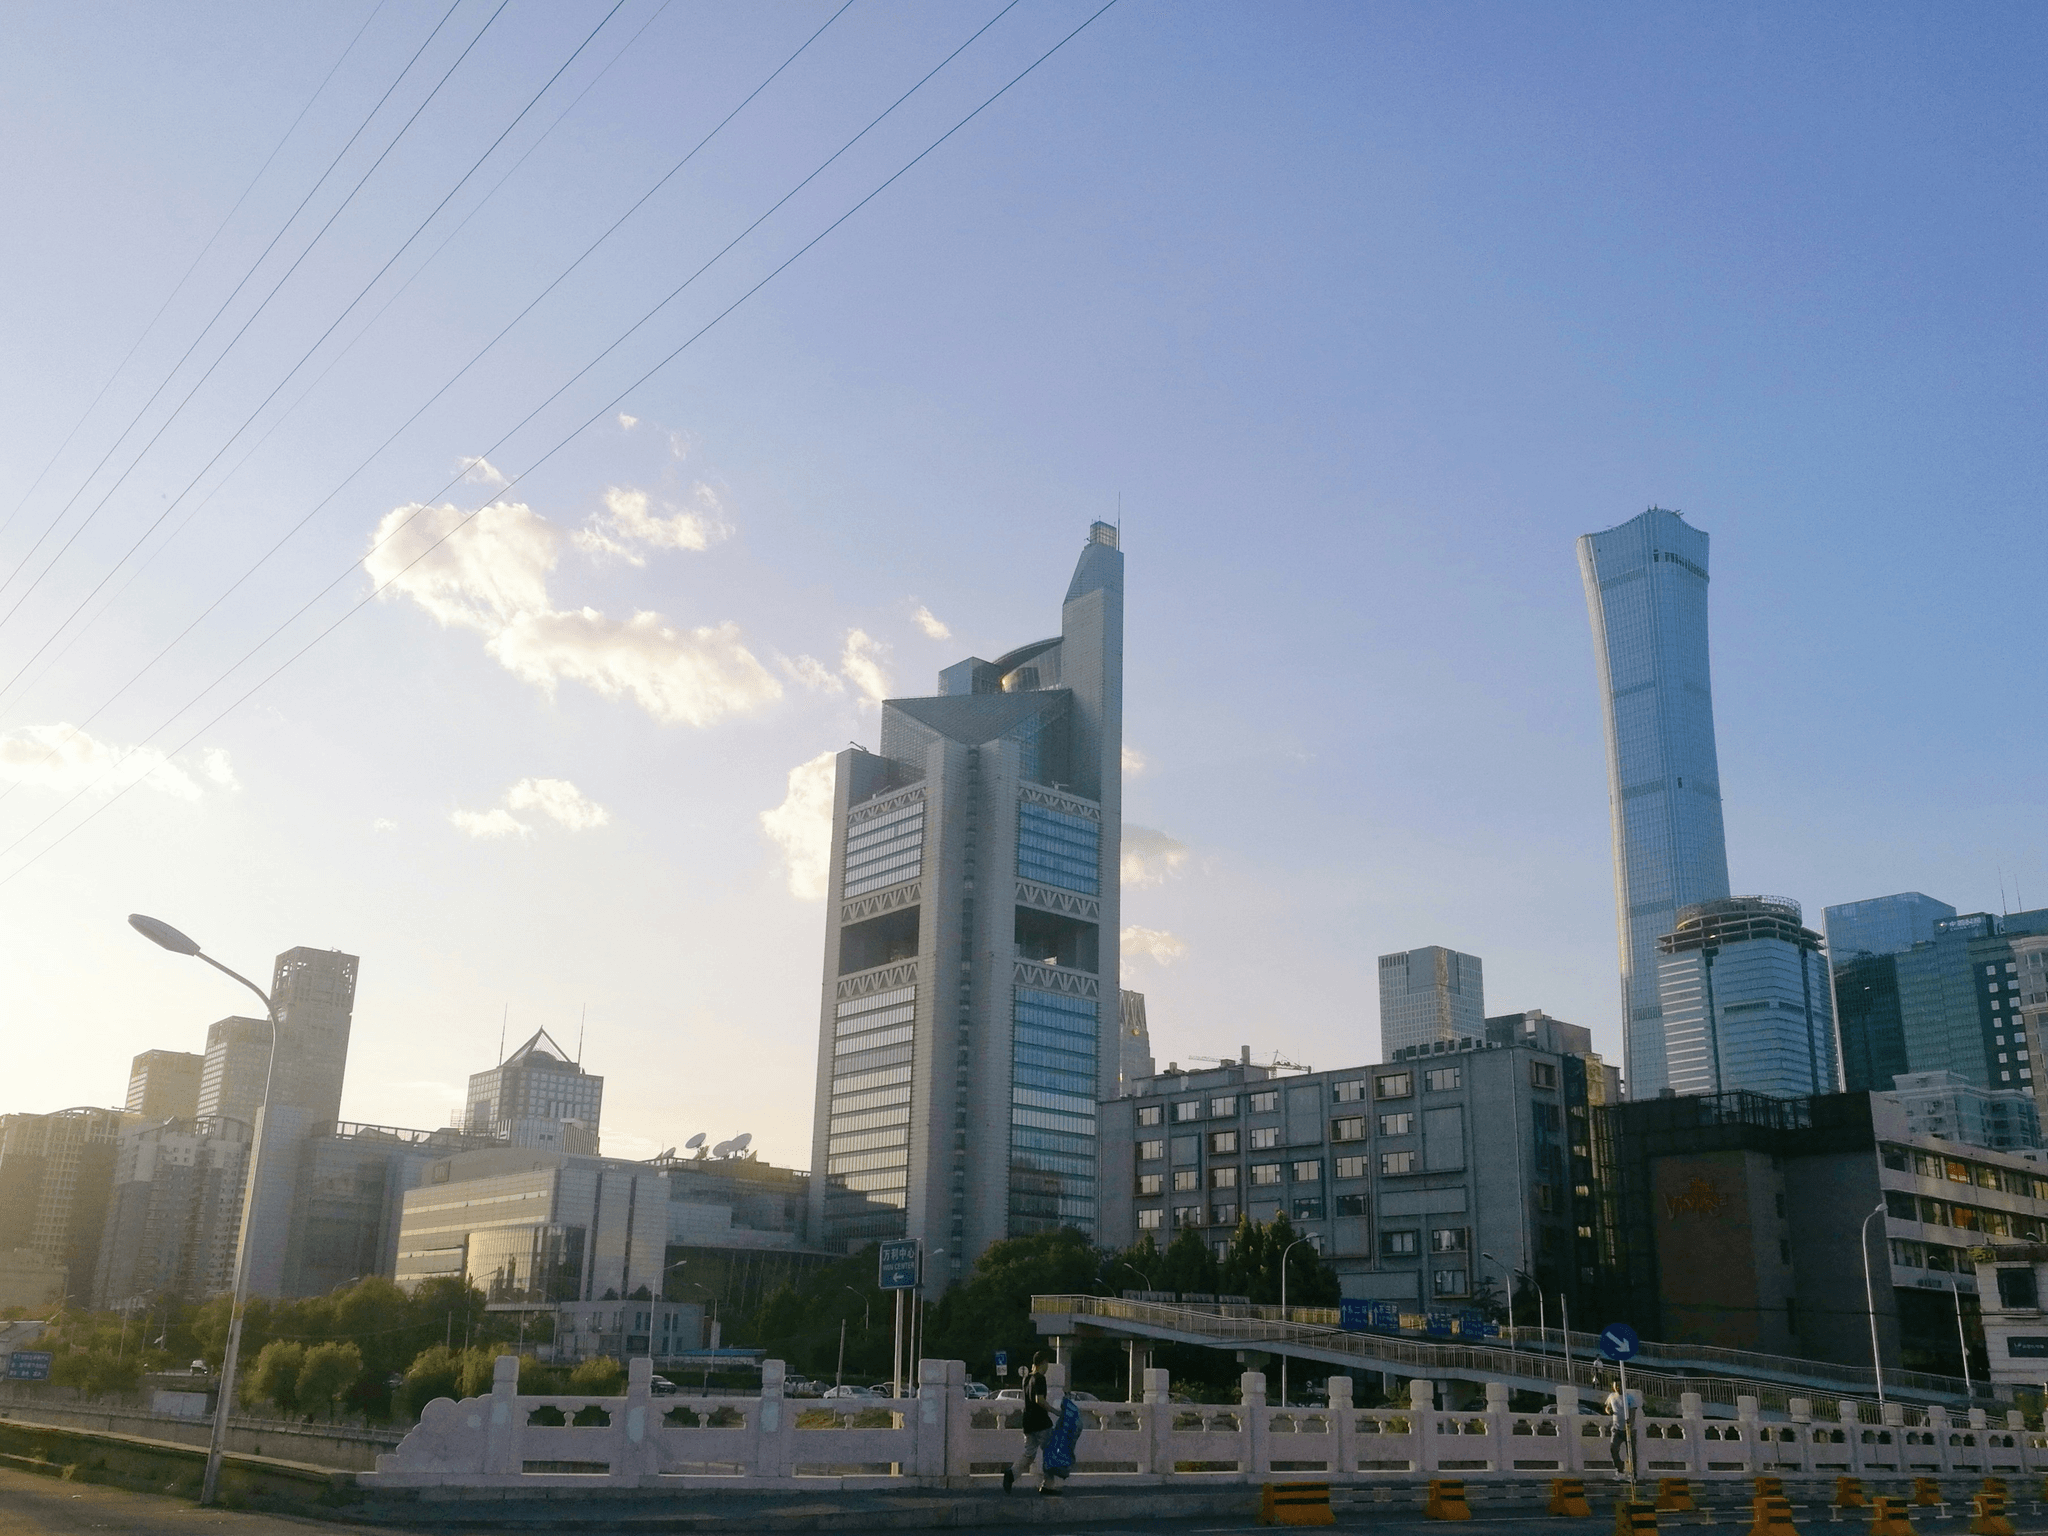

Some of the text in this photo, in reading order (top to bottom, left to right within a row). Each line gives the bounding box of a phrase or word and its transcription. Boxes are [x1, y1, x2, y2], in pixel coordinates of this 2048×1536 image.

[883, 1247, 915, 1261] 万利中心
[894, 1261, 915, 1270] CENTER
